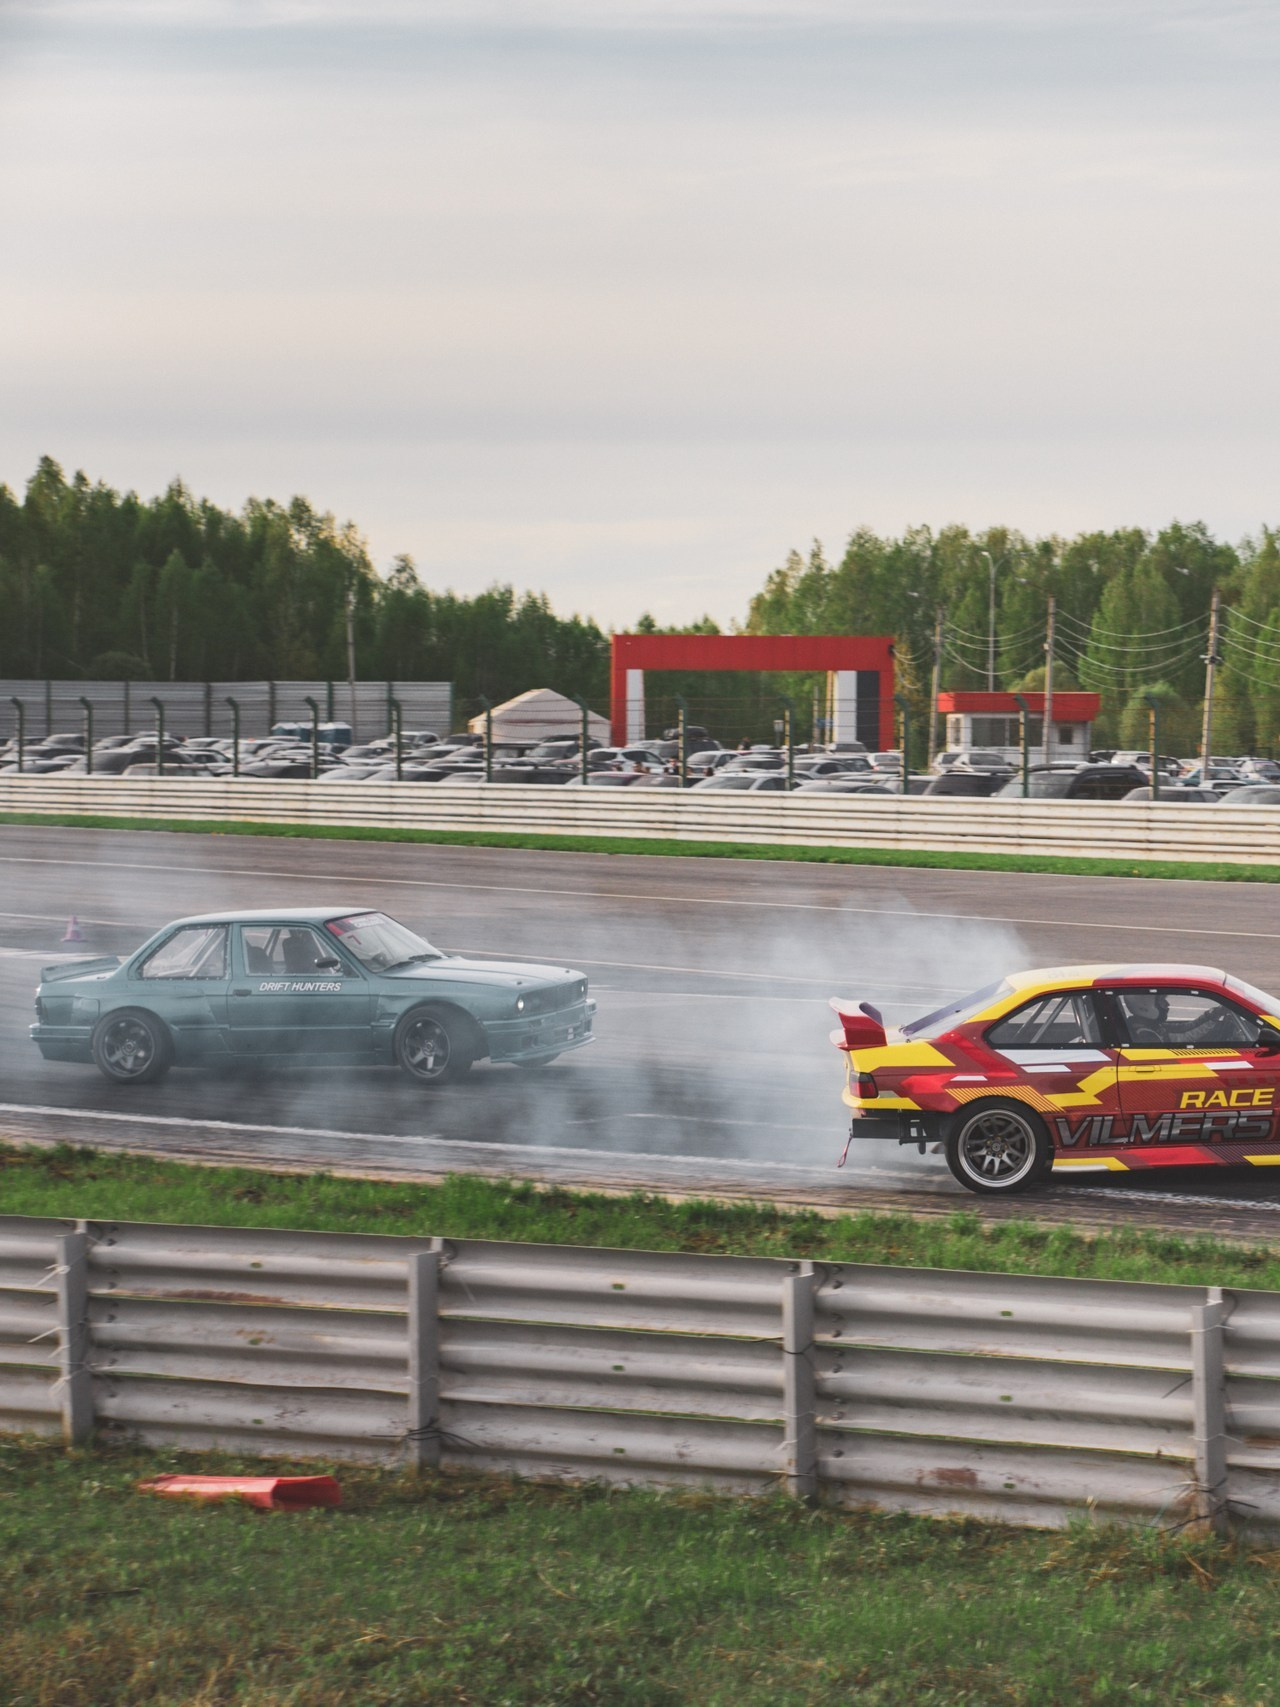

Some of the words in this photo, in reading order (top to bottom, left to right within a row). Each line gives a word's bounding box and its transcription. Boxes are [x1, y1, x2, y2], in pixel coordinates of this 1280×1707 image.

[259, 982, 291, 991] DRIFT
[291, 982, 342, 991] HUNTERS
[1179, 1088, 1275, 1108] RACE
[1055, 1110, 1273, 1146] VILMERS
